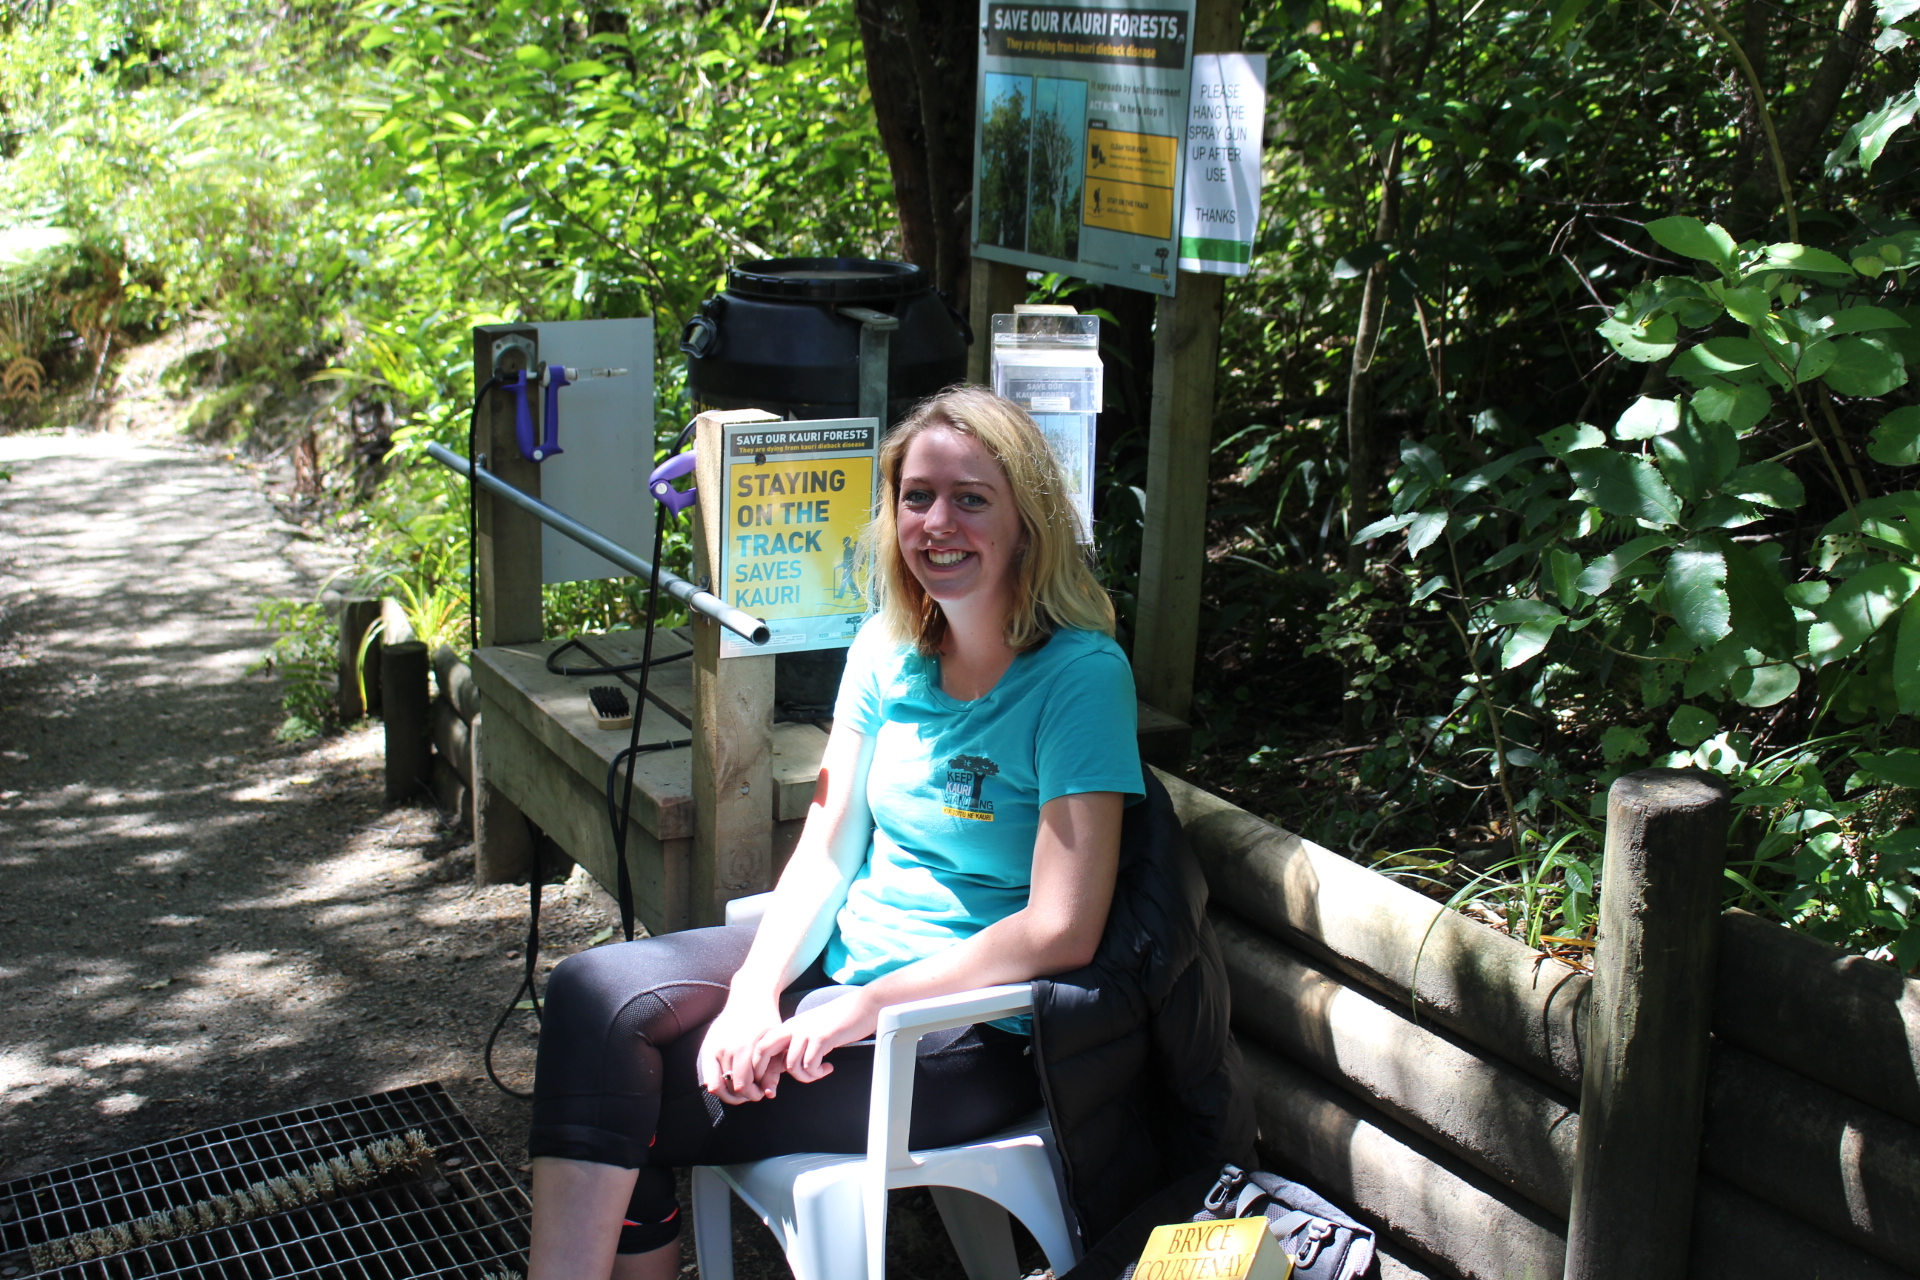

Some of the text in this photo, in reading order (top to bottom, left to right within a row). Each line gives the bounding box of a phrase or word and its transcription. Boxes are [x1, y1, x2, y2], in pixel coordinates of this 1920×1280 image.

[994, 8, 1178, 40] SAVE OUR KAURI FORESTS
[1006, 37, 1157, 59] They are dying from kauri dieback disease
[1097, 82, 1122, 93] spreads
[1123, 83, 1132, 95] by
[1133, 84, 1145, 95] soil
[1146, 87, 1181, 98] movement
[1201, 84, 1240, 99] PLEASE
[1143, 105, 1157, 117] stop
[1193, 105, 1245, 120] HANG THE
[1188, 125, 1247, 141] SPRAY GUN
[1192, 146, 1242, 162] UP AFTER
[1206, 167, 1227, 182] USE
[1195, 207, 1236, 224] THANKS
[736, 429, 868, 446] SAVE OUR KAURI FORESTS
[766, 445, 784, 453] dying
[737, 469, 846, 498] STAYING
[737, 500, 830, 528] ON THE
[736, 530, 823, 558] TRACK
[735, 559, 802, 583] SAVES
[735, 585, 800, 608] KAURI
[947, 771, 973, 784] KEEP
[946, 782, 972, 796] KAURI
[975, 813, 992, 821] KAURI
[1167, 1223, 1235, 1255] BRYCE
[1135, 1253, 1250, 1280] COURTENAY
